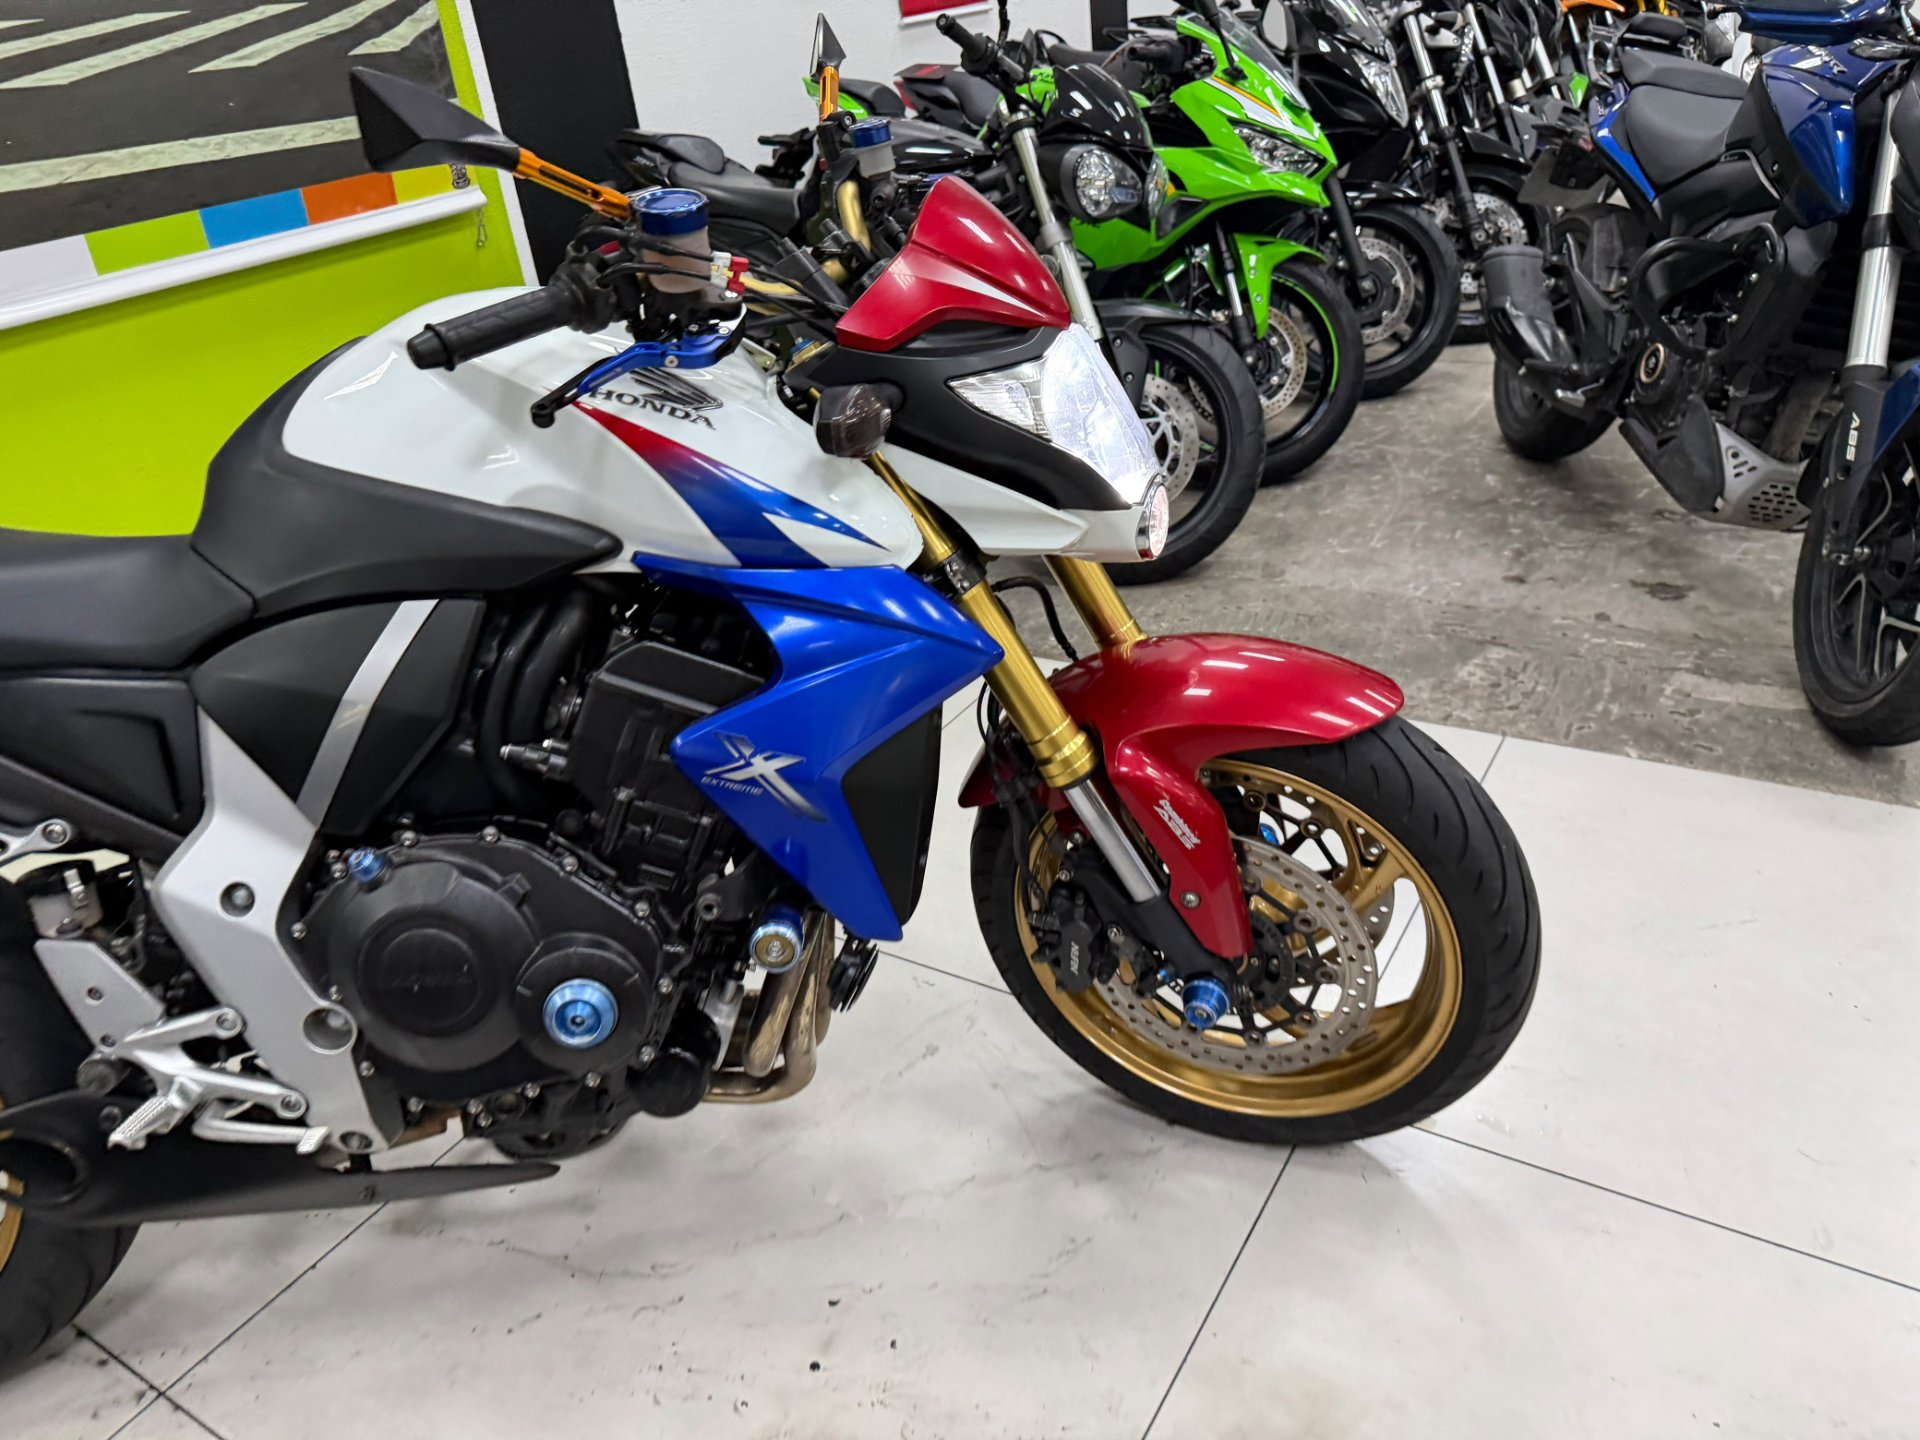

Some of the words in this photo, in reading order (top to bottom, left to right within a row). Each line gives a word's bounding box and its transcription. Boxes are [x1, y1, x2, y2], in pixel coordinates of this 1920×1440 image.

[587, 387, 717, 431] HONDA
[1845, 411, 1860, 462] ABS
[1153, 805, 1195, 850] ABS
